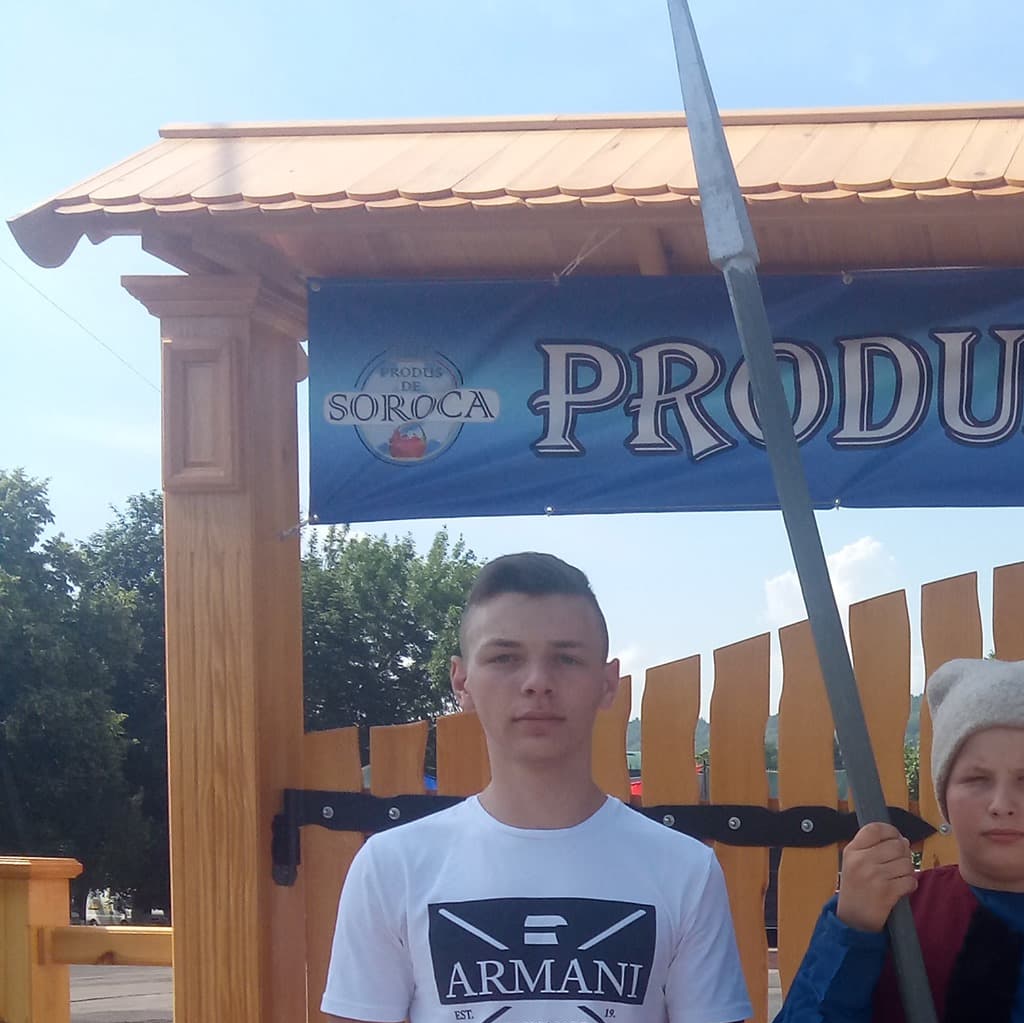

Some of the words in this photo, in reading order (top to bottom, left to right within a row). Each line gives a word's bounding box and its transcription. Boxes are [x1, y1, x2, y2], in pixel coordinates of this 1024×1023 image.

[379, 366, 444, 379] PRODUS
[400, 380, 423, 392] DE
[328, 389, 496, 422] SOROCA
[446, 958, 644, 998] ARMANI
[454, 1009, 475, 1020] EST.
